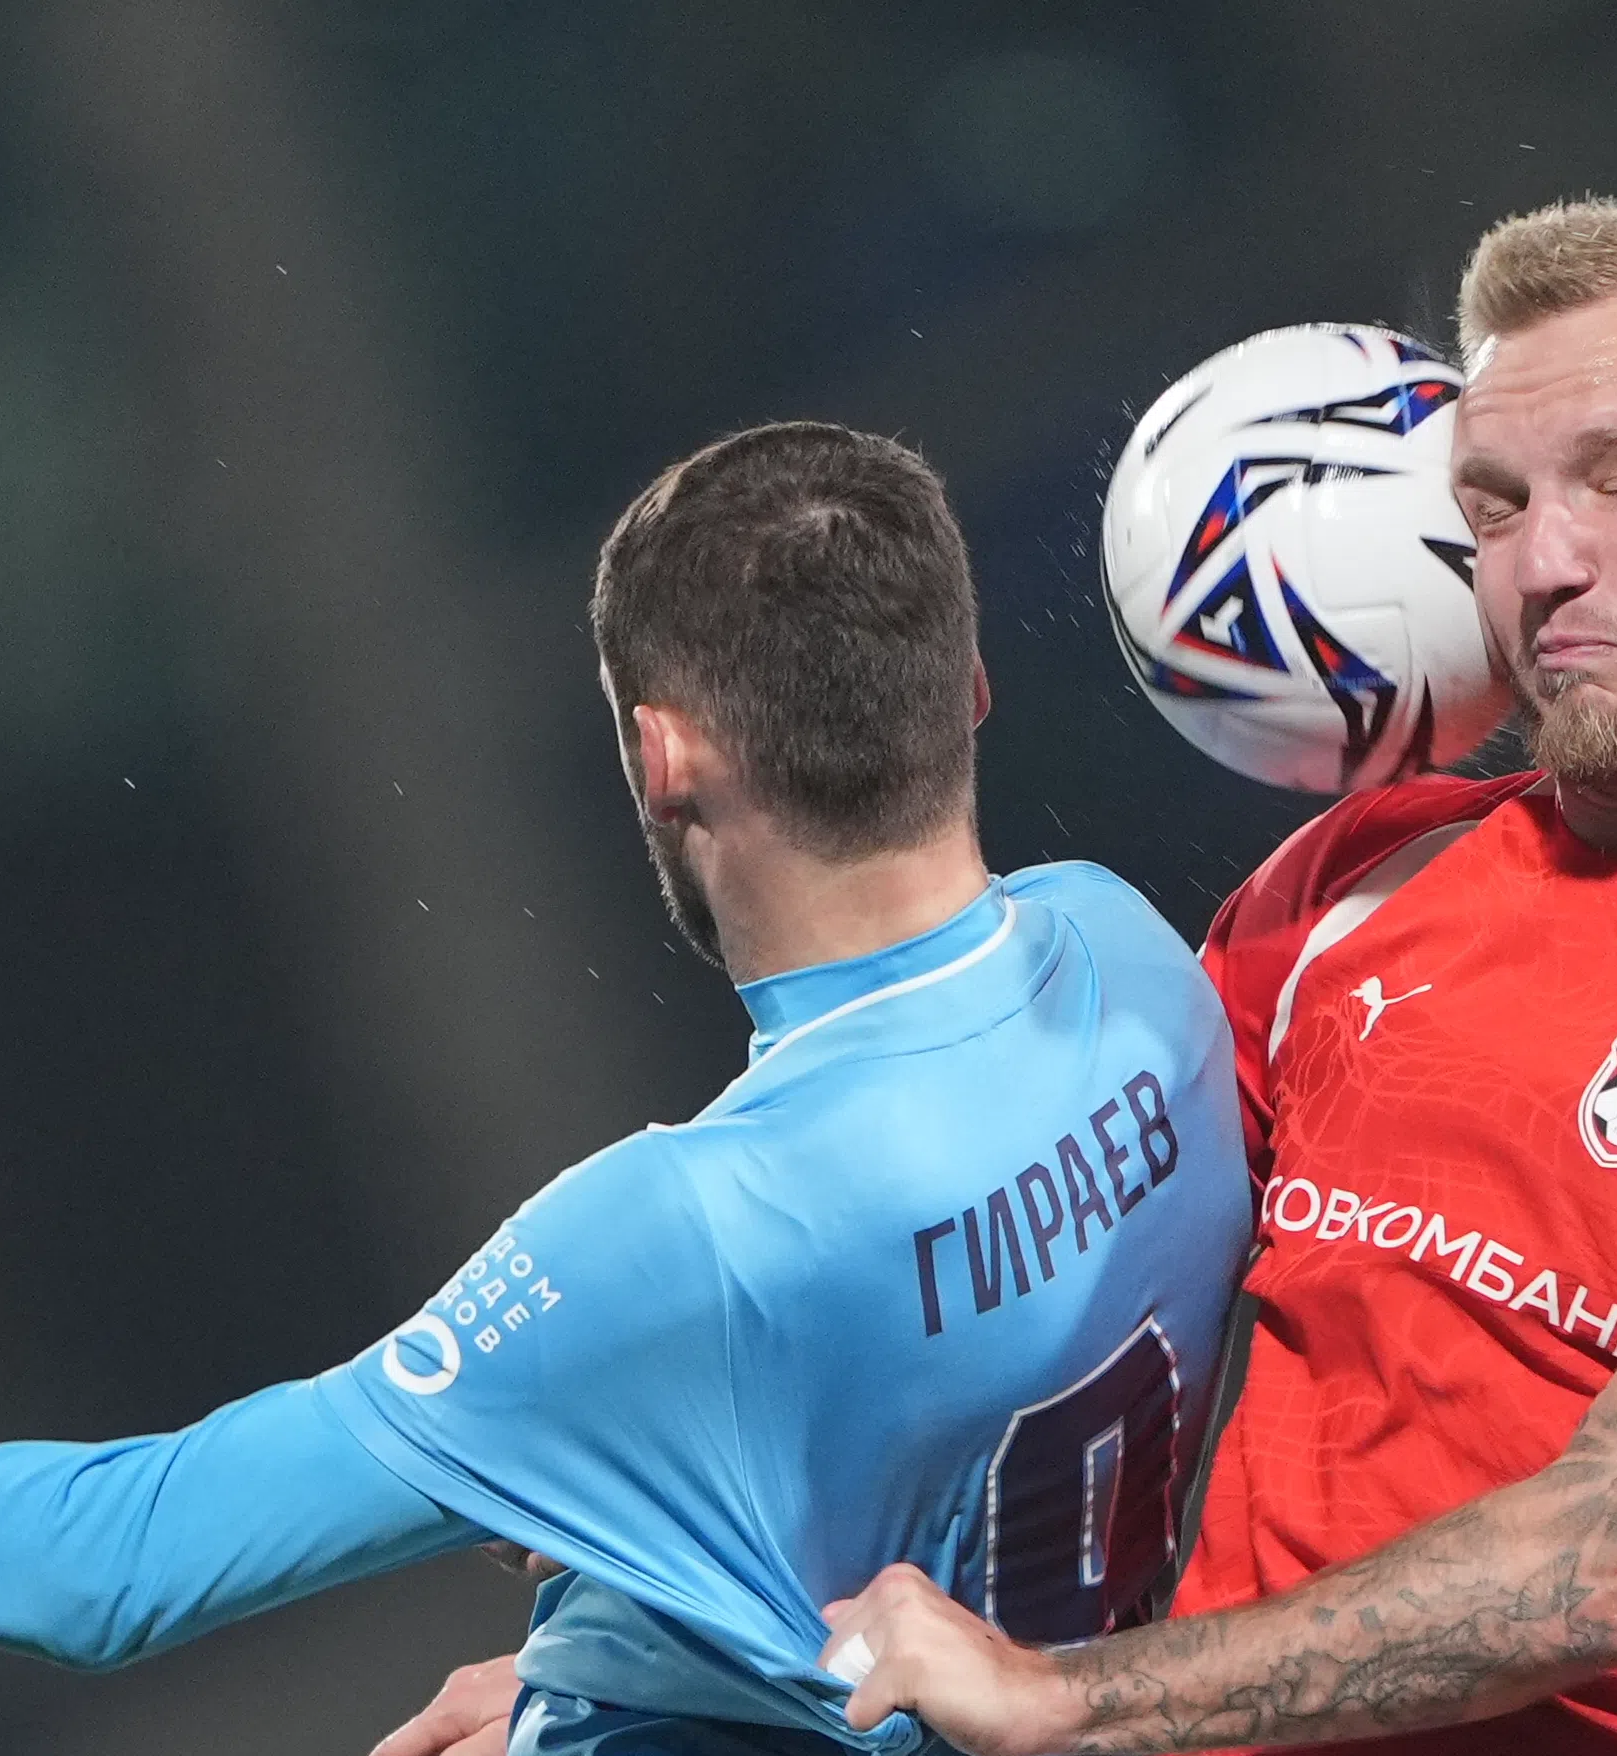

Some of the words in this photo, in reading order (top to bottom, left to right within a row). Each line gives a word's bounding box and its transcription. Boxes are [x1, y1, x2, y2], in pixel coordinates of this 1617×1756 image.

[912, 1069, 1180, 1338] ГИРАЕВ
[468, 1259, 531, 1332] ОДЕ
[488, 1235, 562, 1313] ДОМ
